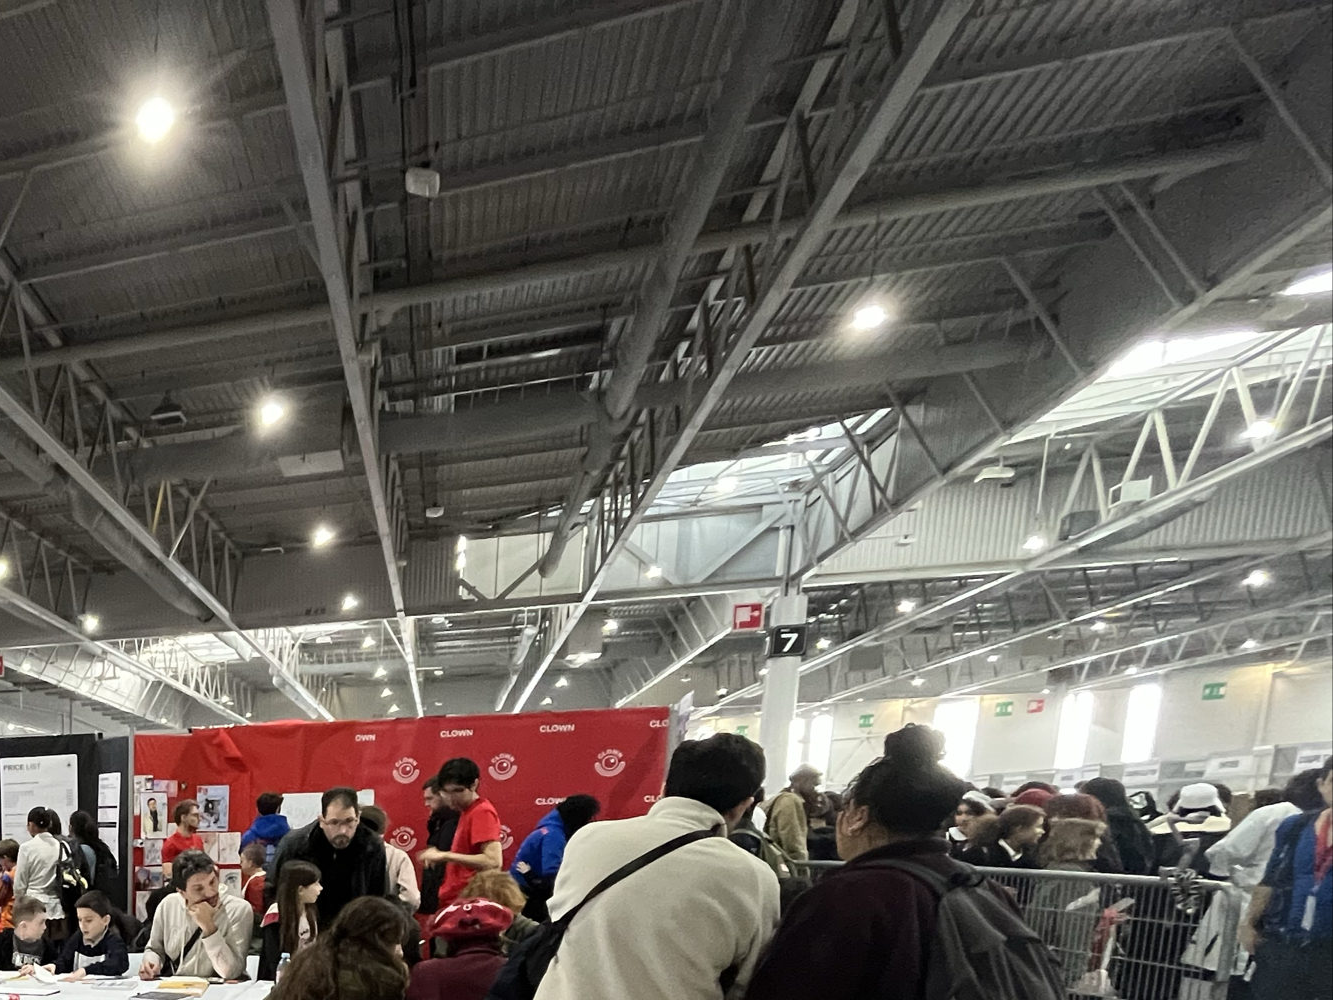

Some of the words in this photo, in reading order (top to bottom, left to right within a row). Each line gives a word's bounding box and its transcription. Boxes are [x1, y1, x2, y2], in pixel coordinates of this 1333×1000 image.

[780, 633, 799, 653] 7
[539, 724, 575, 733] CLOWN
[440, 730, 473, 738] CLOWN
[491, 753, 515, 763] CLOWN
[597, 749, 623, 759] CLOWN
[395, 757, 418, 767] CLOWN
[392, 826, 415, 836] CLOWN
